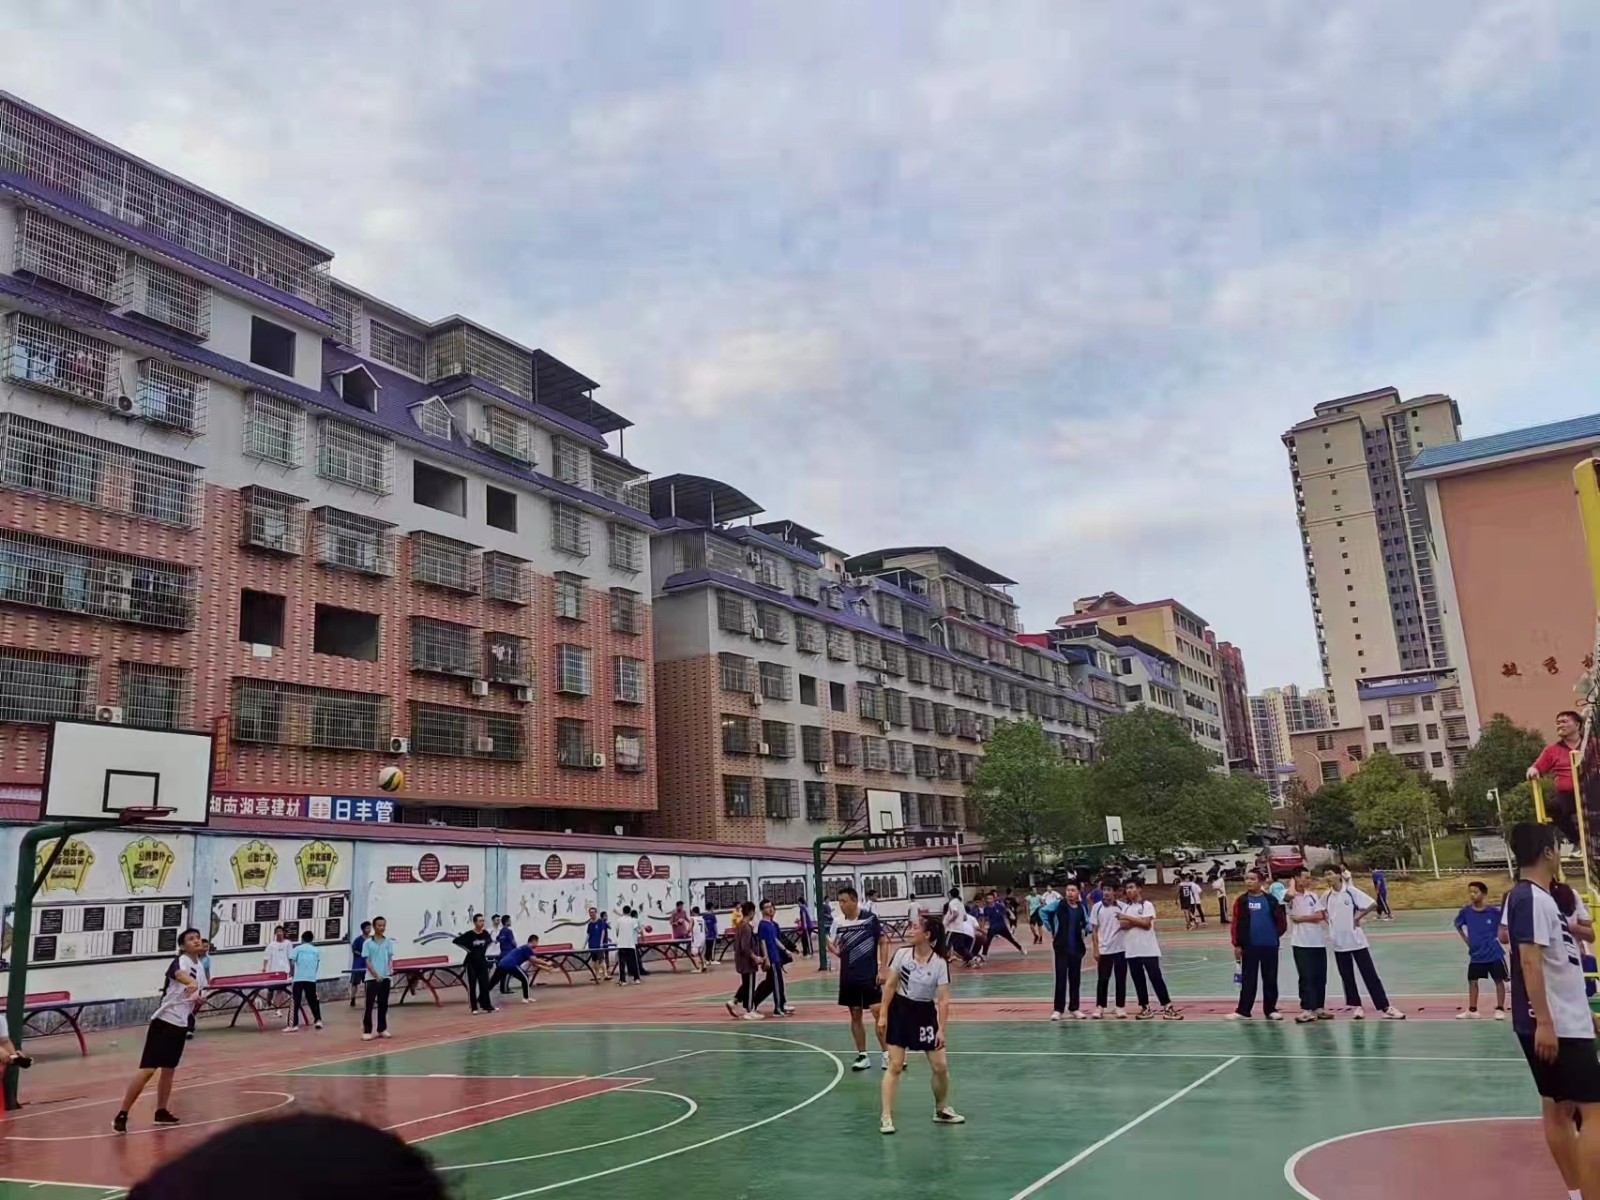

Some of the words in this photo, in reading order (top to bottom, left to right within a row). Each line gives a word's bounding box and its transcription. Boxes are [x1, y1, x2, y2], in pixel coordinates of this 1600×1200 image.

[335, 799, 394, 823] 日丰管
[919, 1026, 935, 1043] 23
